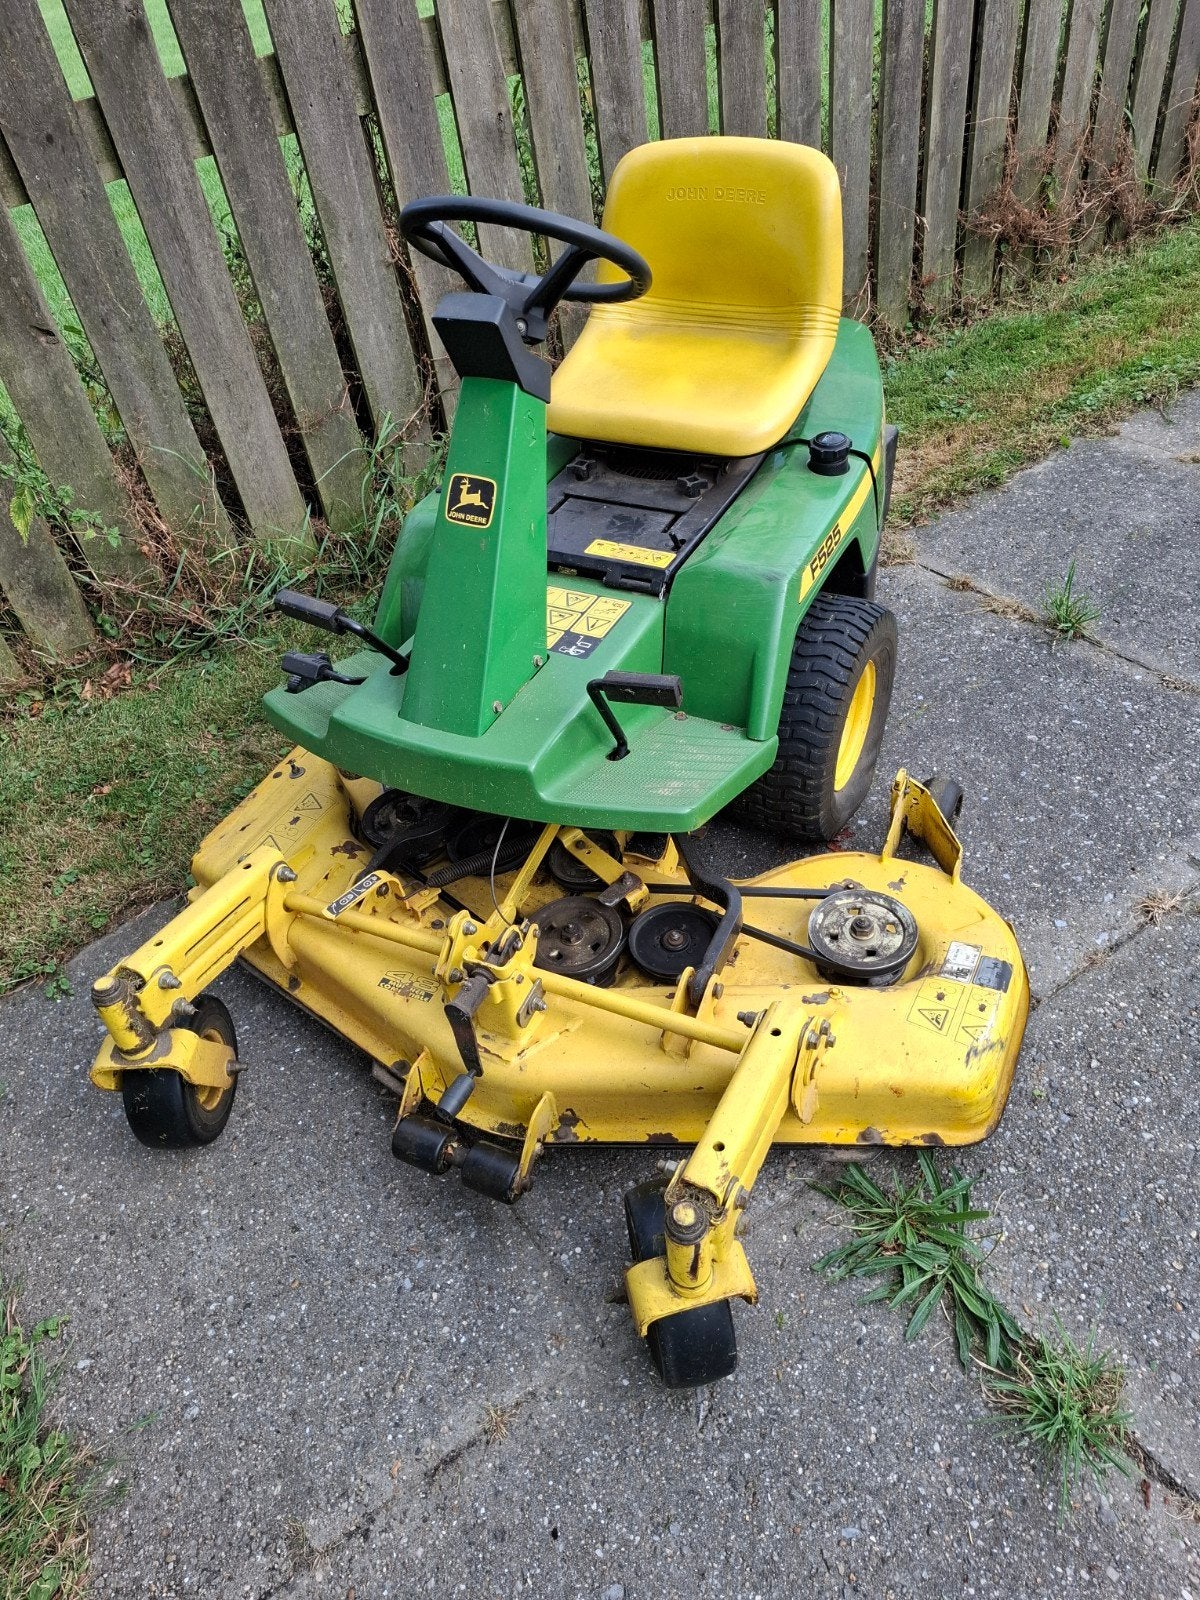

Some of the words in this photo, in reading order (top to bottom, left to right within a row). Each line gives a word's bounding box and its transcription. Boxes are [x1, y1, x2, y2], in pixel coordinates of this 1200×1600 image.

[665, 186, 709, 202] JOHN
[713, 186, 767, 205] DEERE
[449, 511, 465, 520] JOHN
[465, 514, 487, 524] DEERE
[809, 523, 842, 581] F525
[385, 970, 440, 993] 48
